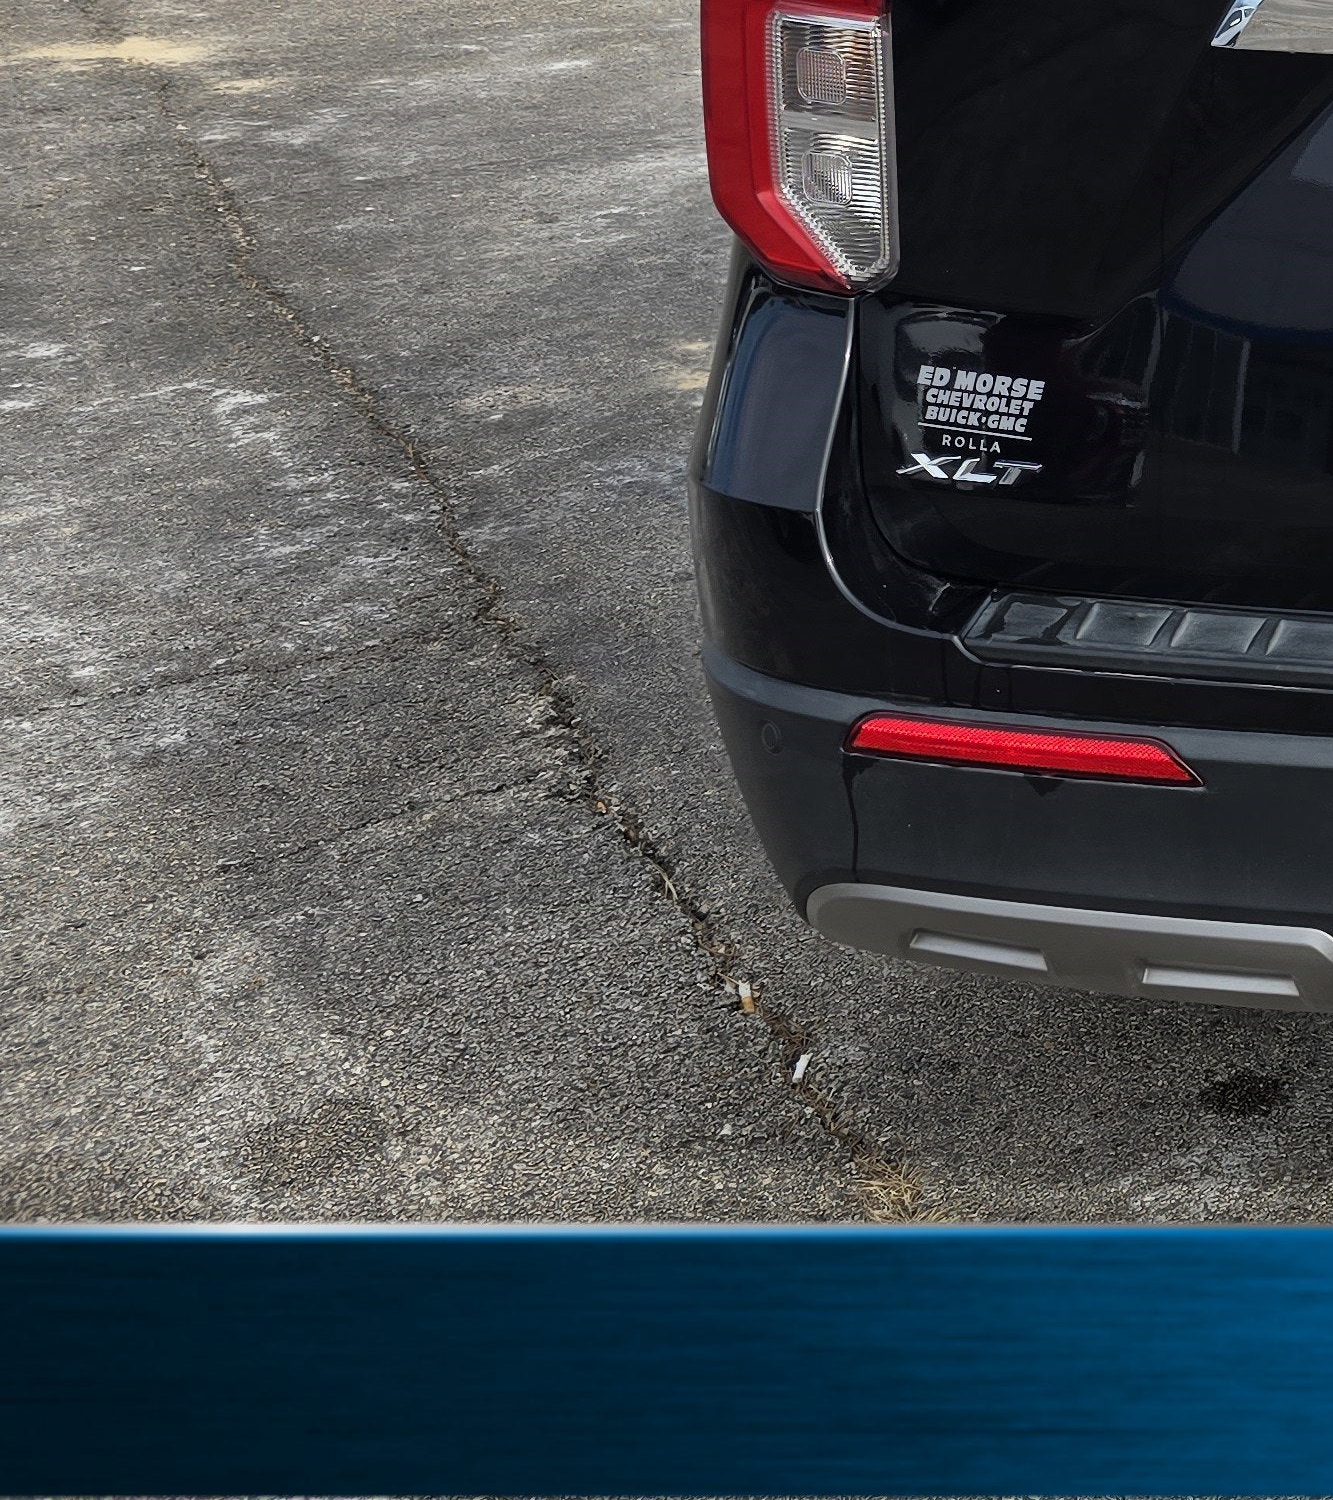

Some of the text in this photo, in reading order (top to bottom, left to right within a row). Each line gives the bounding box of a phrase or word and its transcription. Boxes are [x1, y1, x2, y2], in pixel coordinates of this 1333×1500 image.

[916, 365, 1046, 401] ED MORSE
[925, 388, 1035, 416] CHEVROLET
[941, 434, 1001, 454] ROLLA
[895, 452, 1043, 486] XLT
